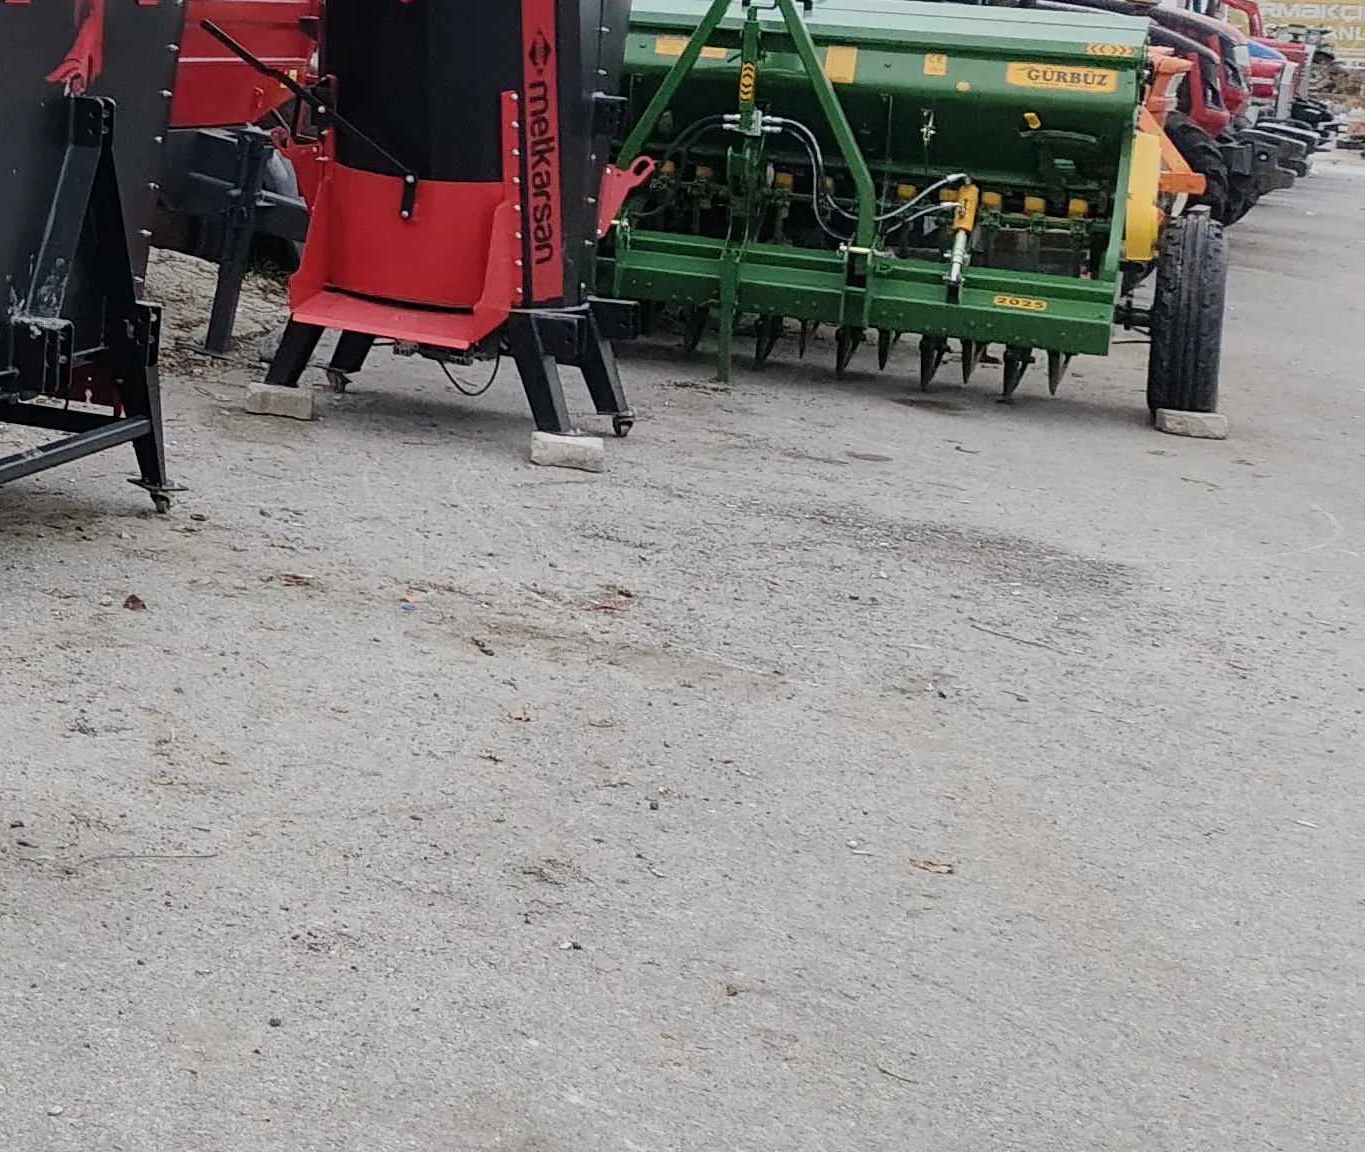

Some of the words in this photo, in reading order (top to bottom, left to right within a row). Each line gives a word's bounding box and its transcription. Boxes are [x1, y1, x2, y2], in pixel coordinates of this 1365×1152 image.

[1026, 67, 1109, 87] GÜRBÜZ
[528, 79, 556, 265] melkarsan
[996, 296, 1044, 309] 2025
